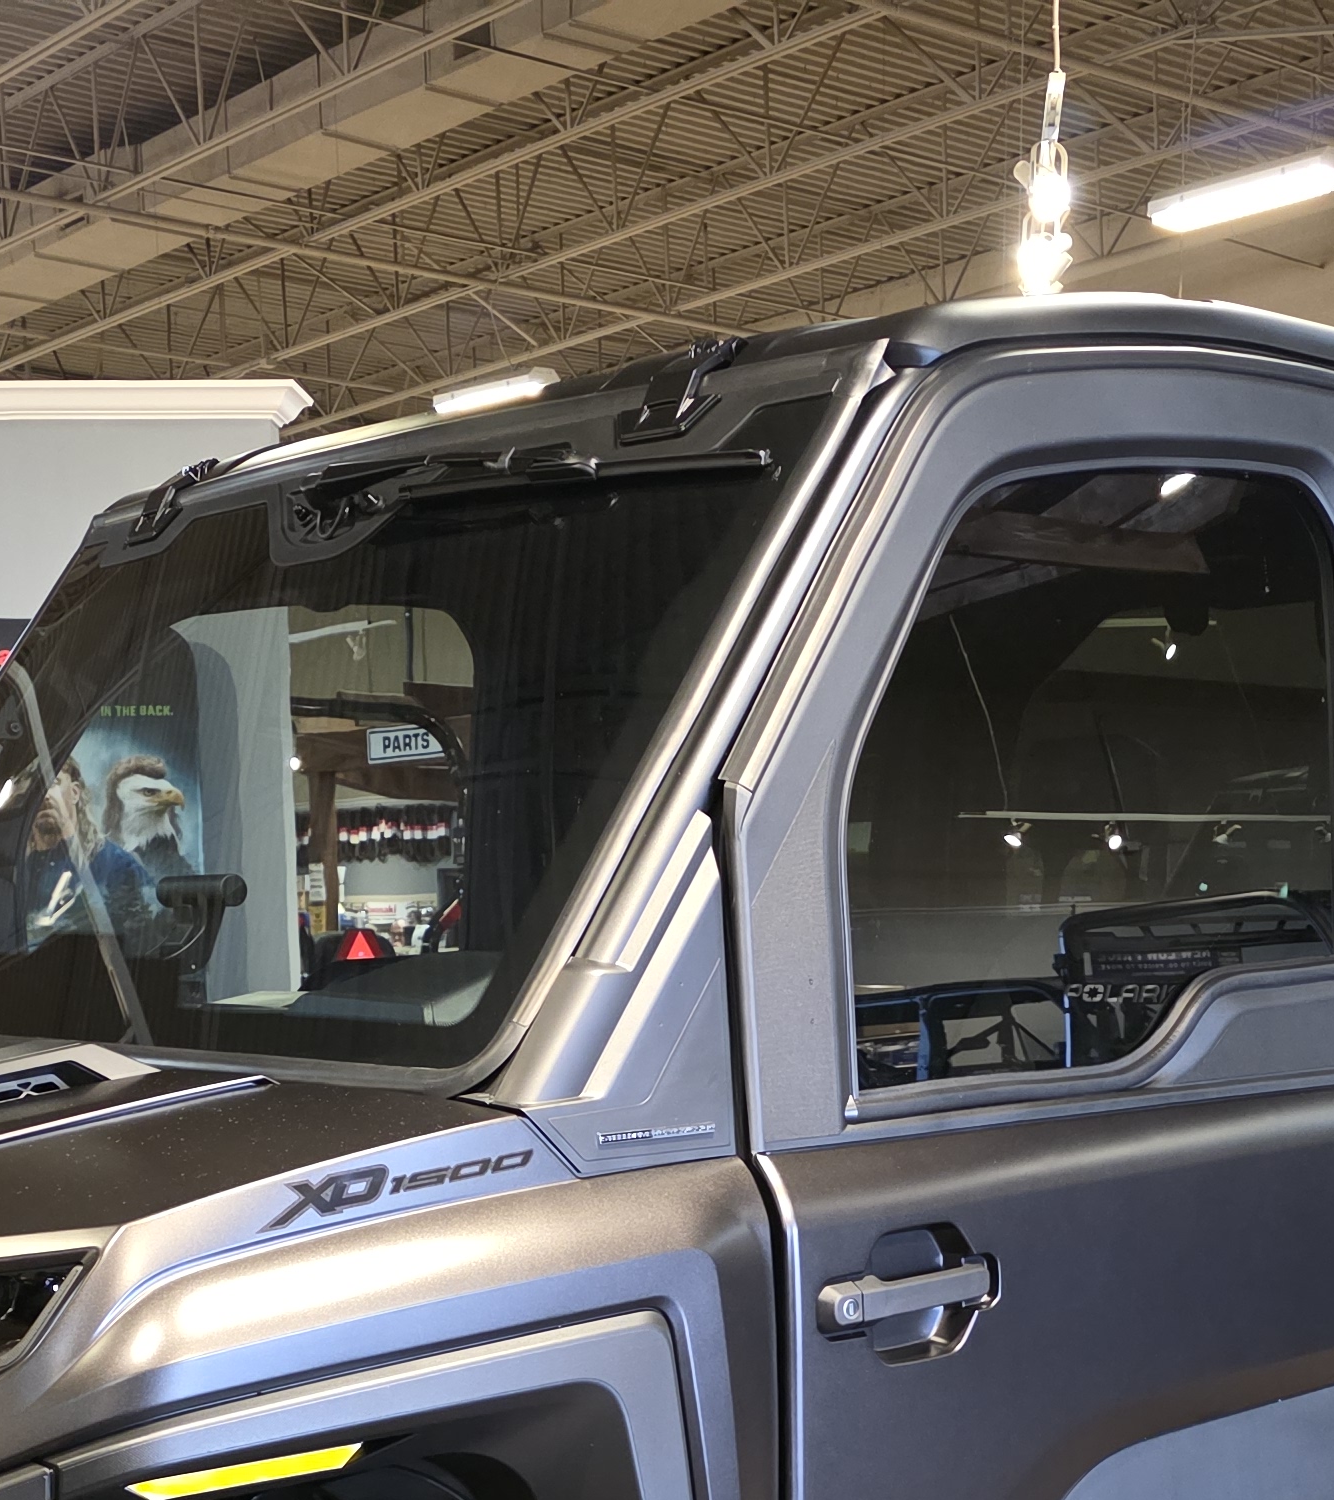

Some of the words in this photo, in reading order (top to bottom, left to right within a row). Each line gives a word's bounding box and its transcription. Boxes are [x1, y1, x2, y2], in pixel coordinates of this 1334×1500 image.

[100, 705, 112, 717] IN
[115, 705, 136, 717] THE
[139, 705, 174, 717] BACK.
[382, 732, 430, 754] PARTS
[256, 1163, 390, 1234] XD
[388, 1148, 534, 1196] 1500
